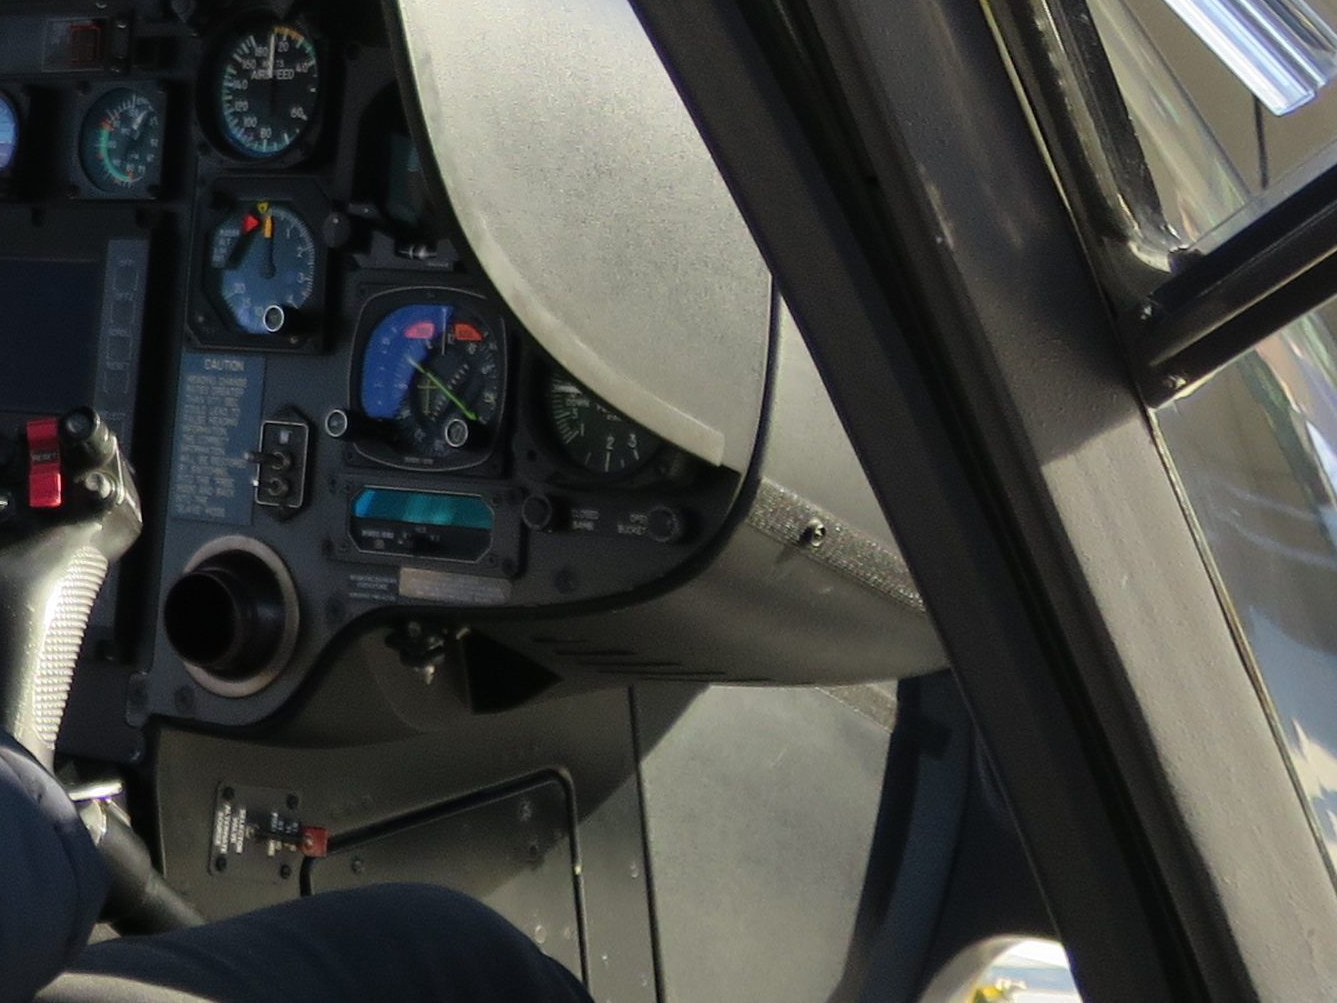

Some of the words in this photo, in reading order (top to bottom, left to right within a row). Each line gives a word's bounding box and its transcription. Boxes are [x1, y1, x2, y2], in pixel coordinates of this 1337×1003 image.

[277, 41, 290, 52] 20
[251, 69, 295, 80] AIRSEED
[290, 107, 304, 118] 60
[243, 117, 258, 128] 100
[260, 127, 272, 139] 80
[203, 358, 245, 371] CAUTION
